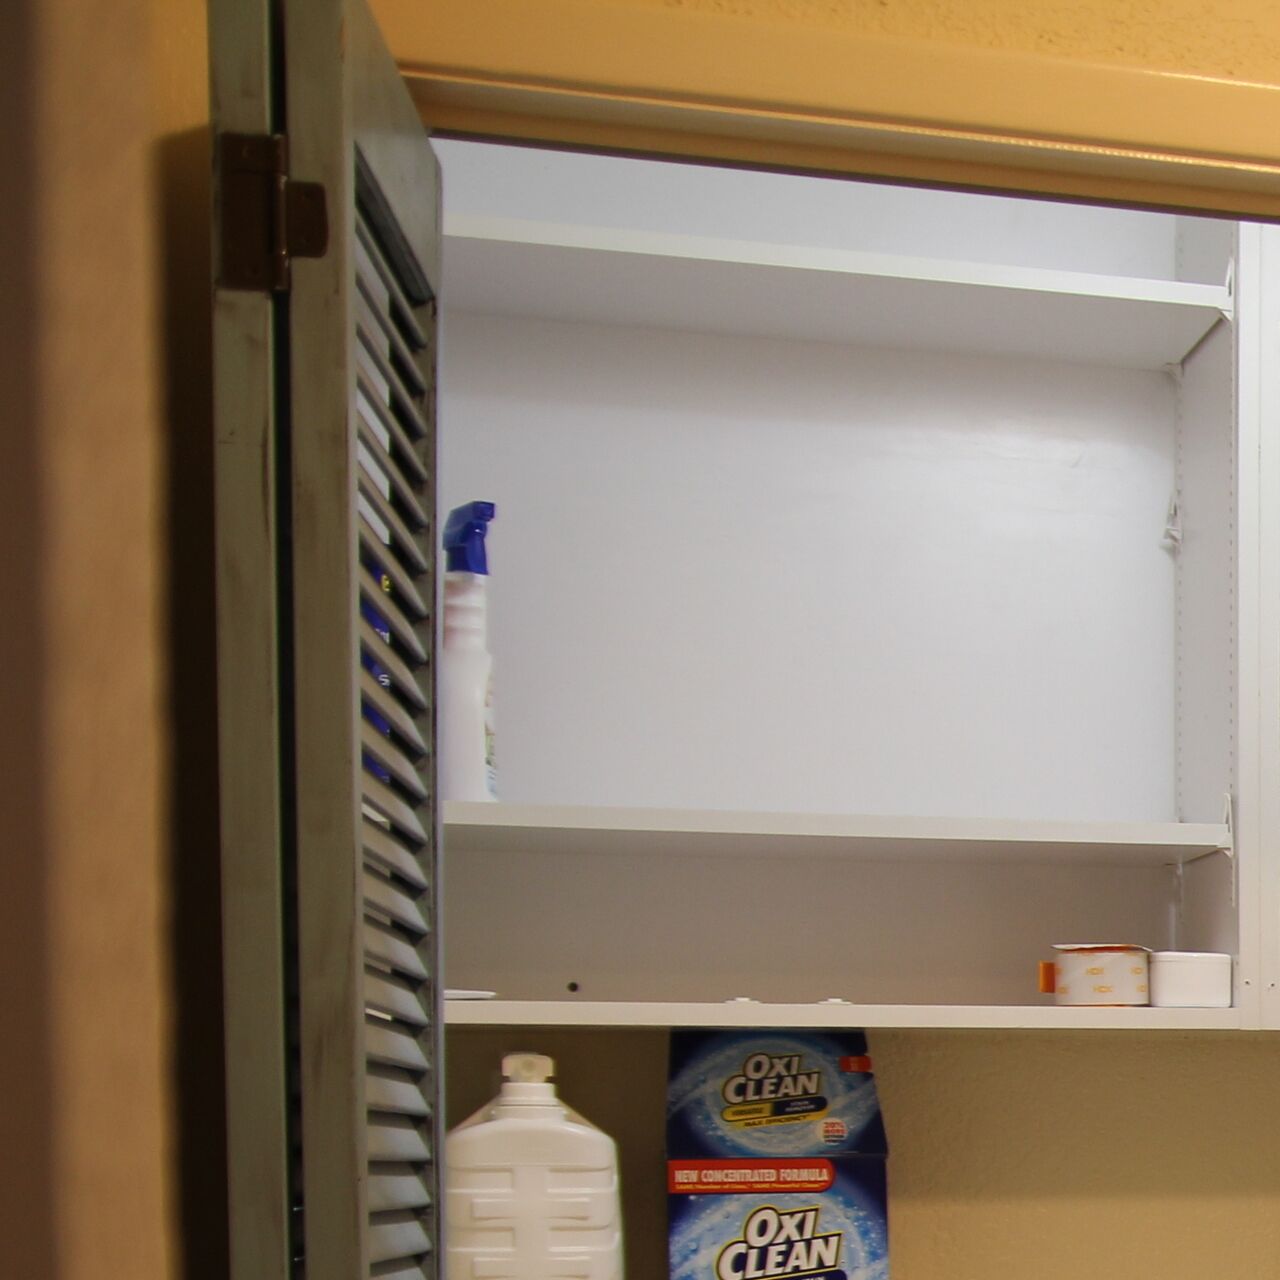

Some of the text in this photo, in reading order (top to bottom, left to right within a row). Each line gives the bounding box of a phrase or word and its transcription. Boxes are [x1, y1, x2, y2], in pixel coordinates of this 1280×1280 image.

[744, 1053, 801, 1080] OXI
[723, 1073, 819, 1104] CLEAN
[674, 1168, 829, 1182] NEW CONCENTRATED FORMULA
[745, 1208, 817, 1248] OXI
